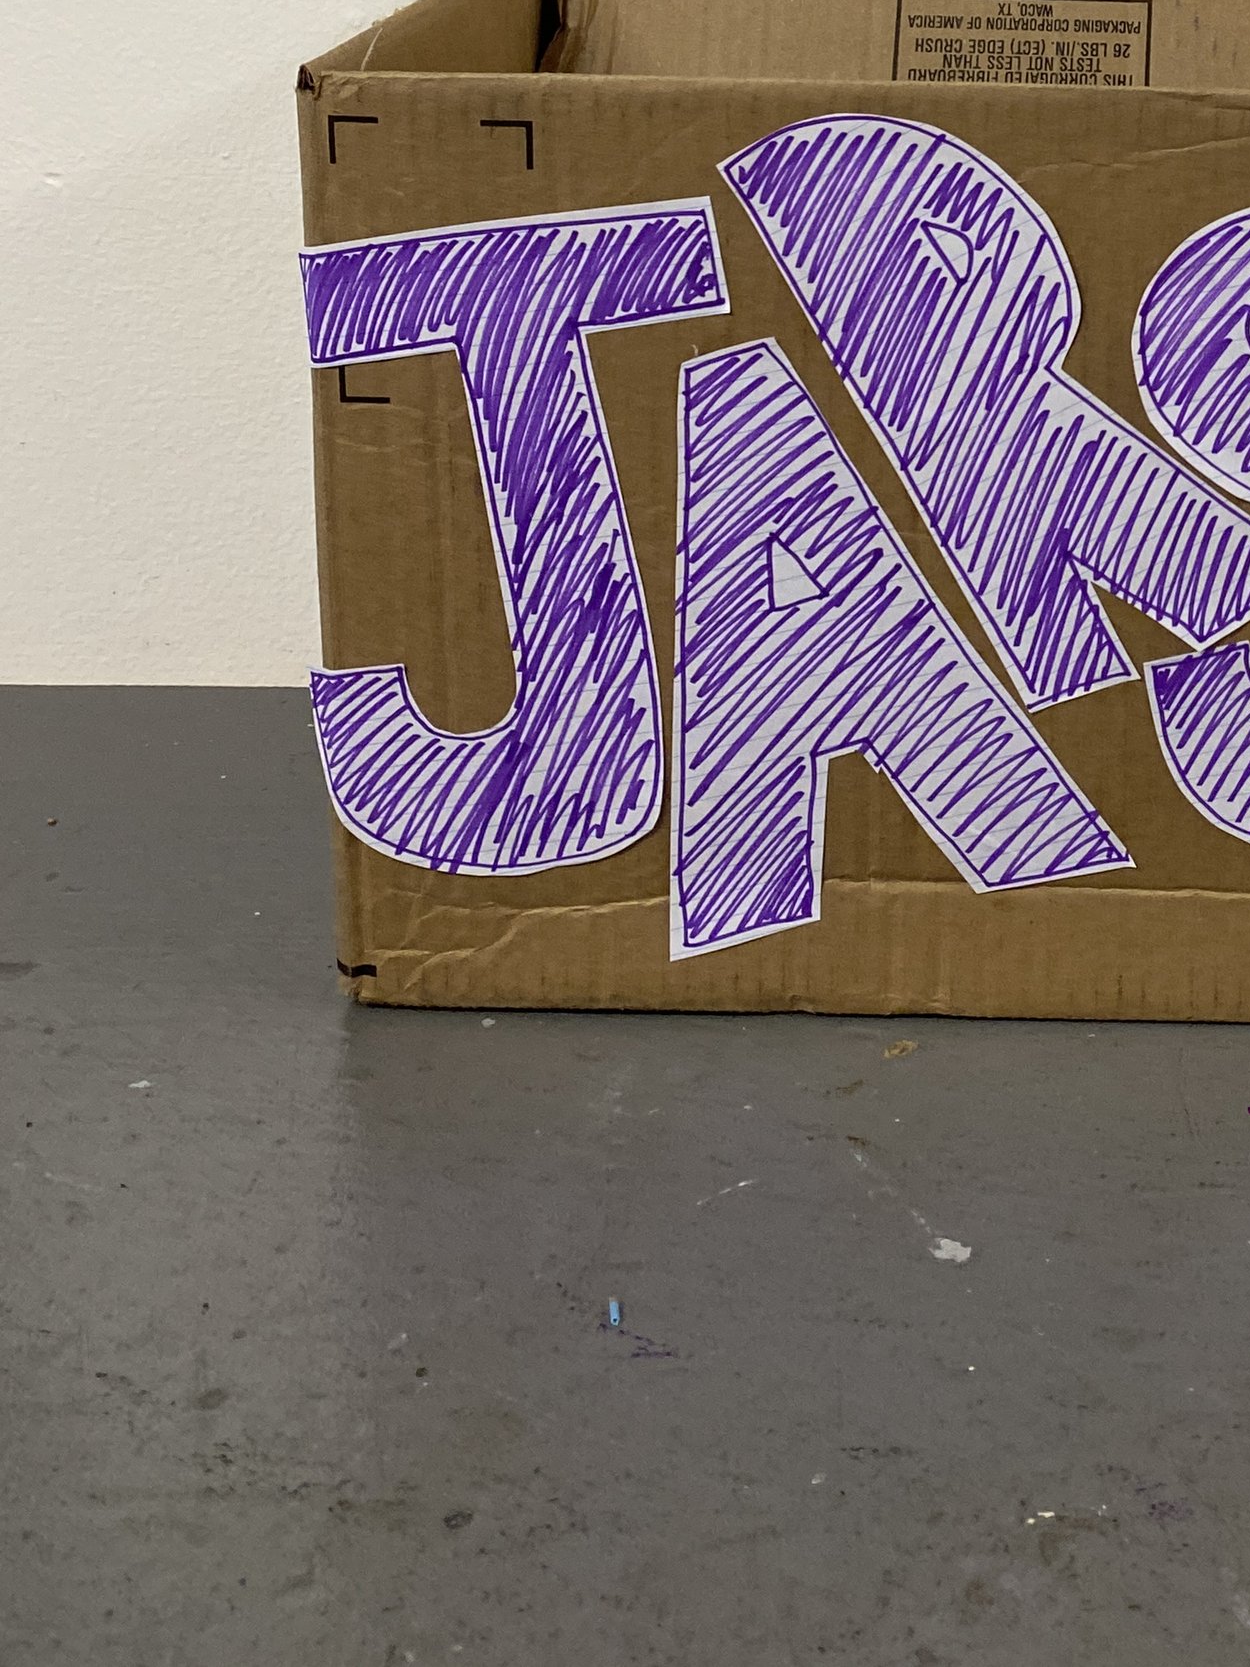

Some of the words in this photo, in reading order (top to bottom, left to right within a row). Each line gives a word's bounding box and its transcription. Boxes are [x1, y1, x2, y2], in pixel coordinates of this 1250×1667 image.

[997, 1, 1012, 16] TX
[1016, 2, 1054, 18] WACO,
[907, 14, 964, 29] AMERICA
[966, 16, 984, 30] OF
[985, 16, 1070, 32] CORPORATION
[1073, 19, 1141, 34] PACKAGING
[915, 38, 964, 53] CRUSH
[968, 39, 1005, 54] EDGE
[1009, 39, 1047, 56] (ECT)
[1051, 41, 1109, 58] LBS./IN.
[1112, 42, 1131, 58] 26
[942, 54, 982, 69] THAN
[987, 55, 1022, 70] LESS
[1026, 56, 1054, 71] NOT
[1059, 57, 1103, 73] TESTS
